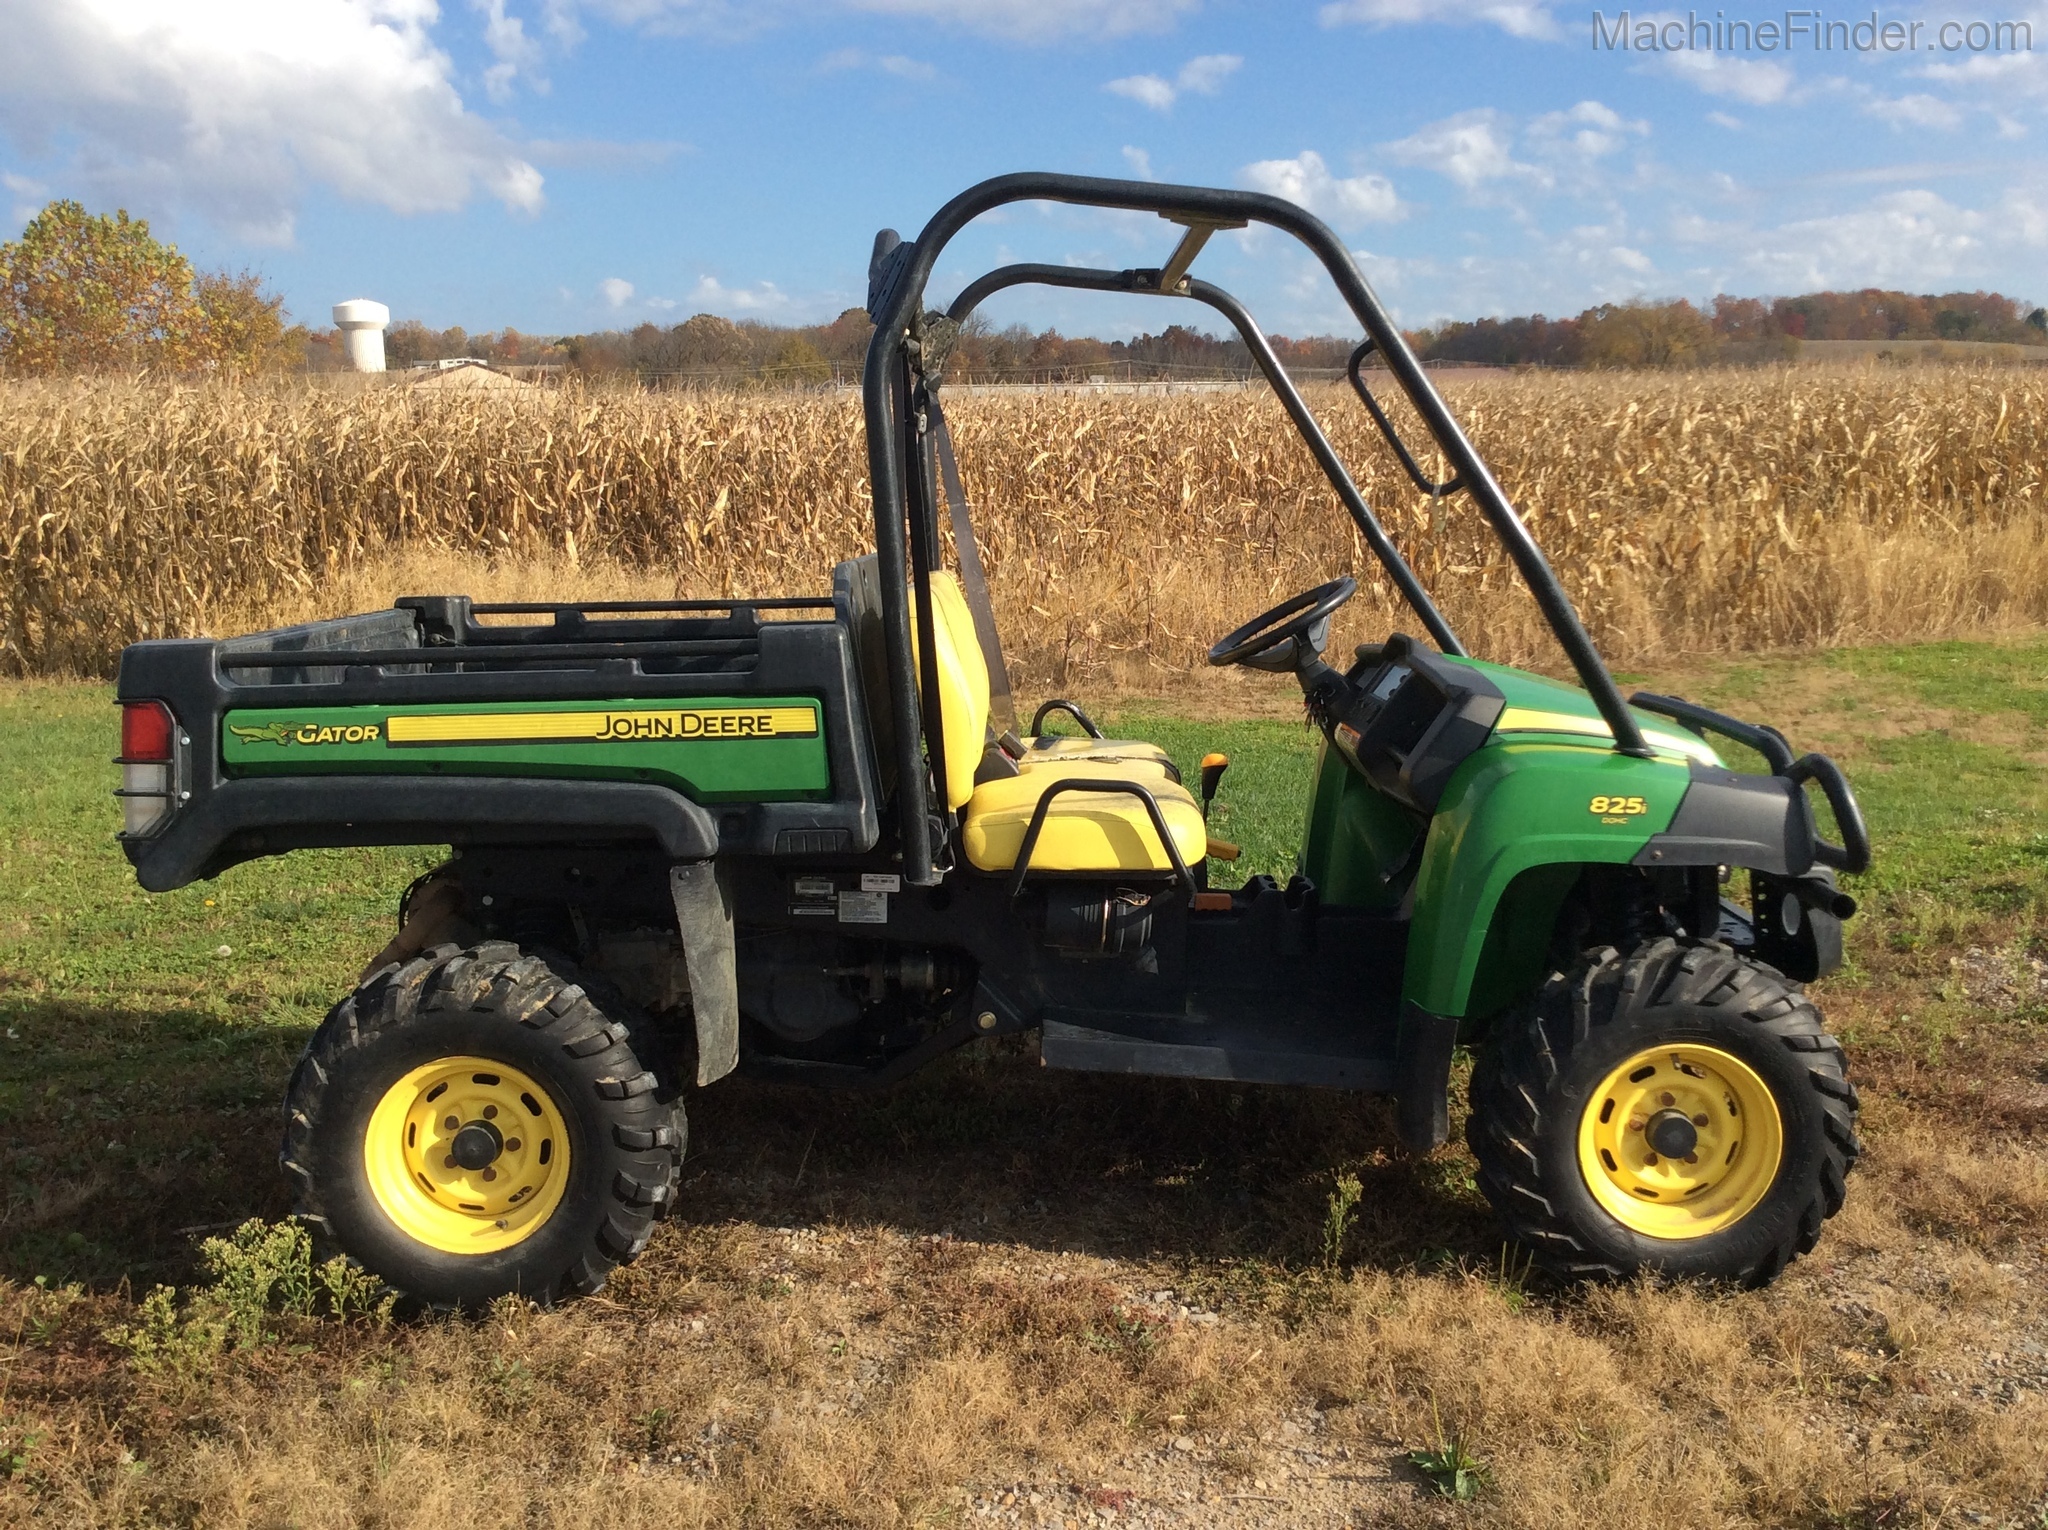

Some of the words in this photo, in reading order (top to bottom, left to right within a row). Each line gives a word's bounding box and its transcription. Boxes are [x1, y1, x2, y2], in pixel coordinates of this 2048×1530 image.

[296, 724, 380, 744] GATOR
[596, 714, 674, 737] JOHN
[680, 712, 774, 735] DEERE
[1589, 796, 1648, 815] 825i
